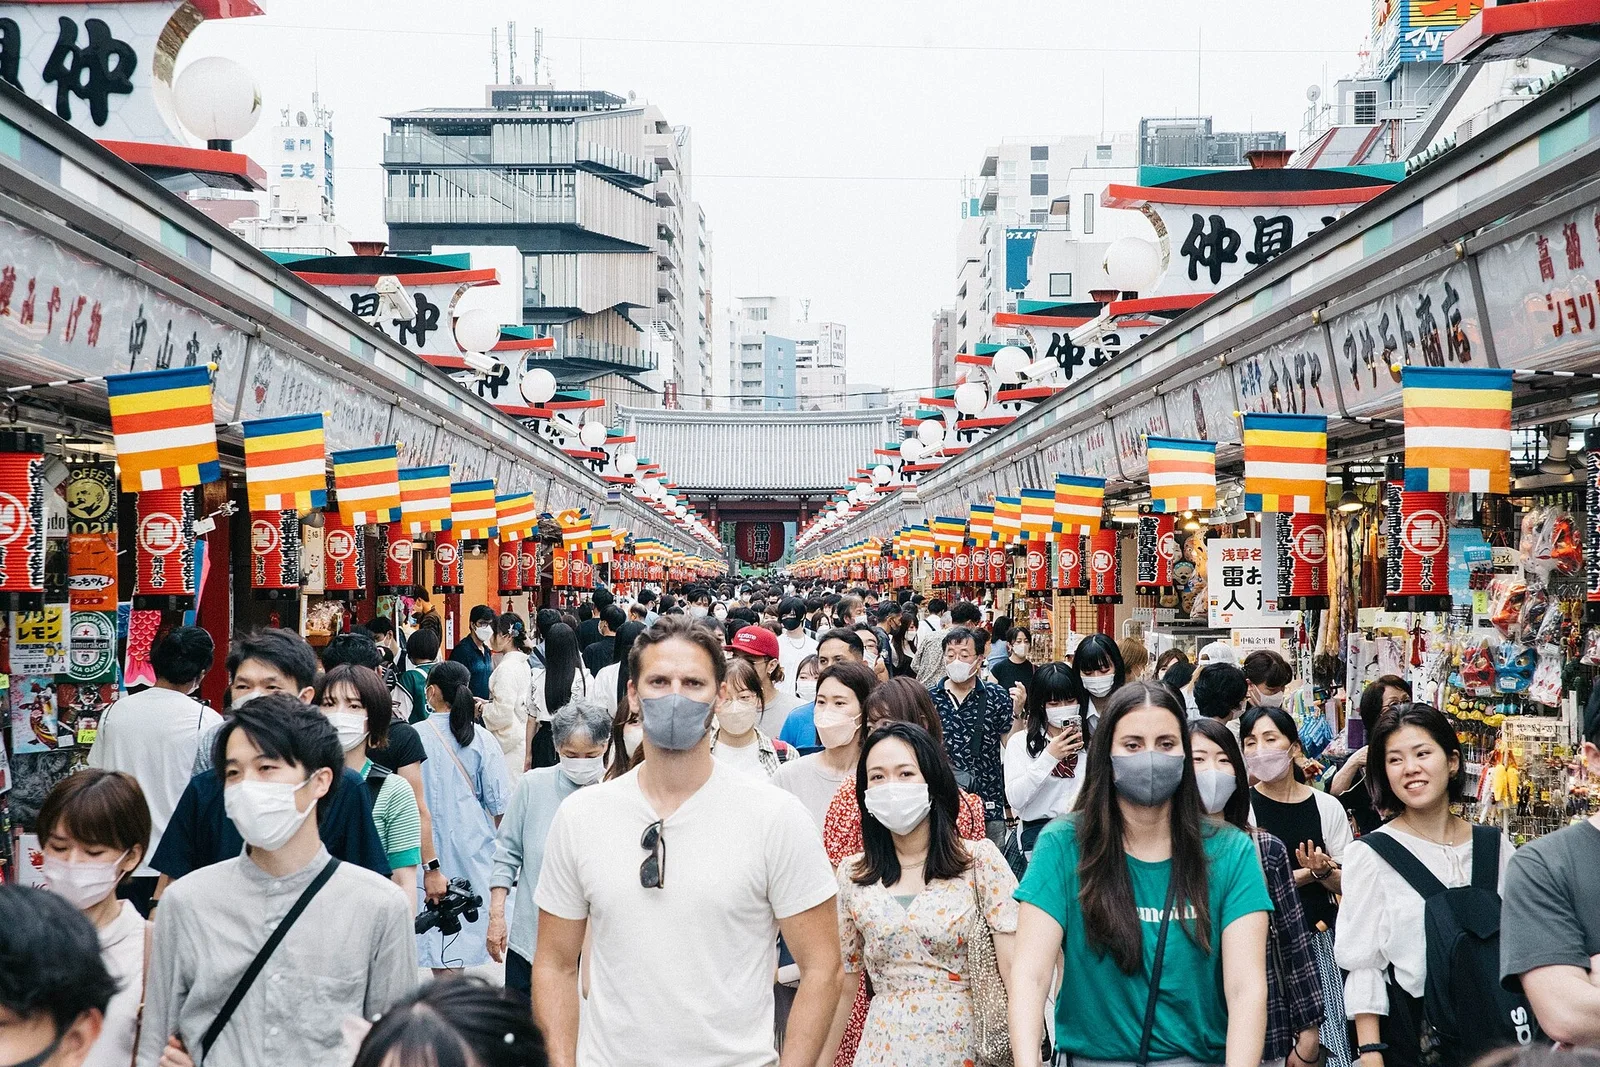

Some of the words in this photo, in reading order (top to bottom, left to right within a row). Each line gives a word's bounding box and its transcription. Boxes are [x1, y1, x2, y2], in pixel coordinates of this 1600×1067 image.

[281, 162, 315, 179] 三定
[1546, 279, 1600, 338] ショッ
[18, 626, 60, 640] レモン
